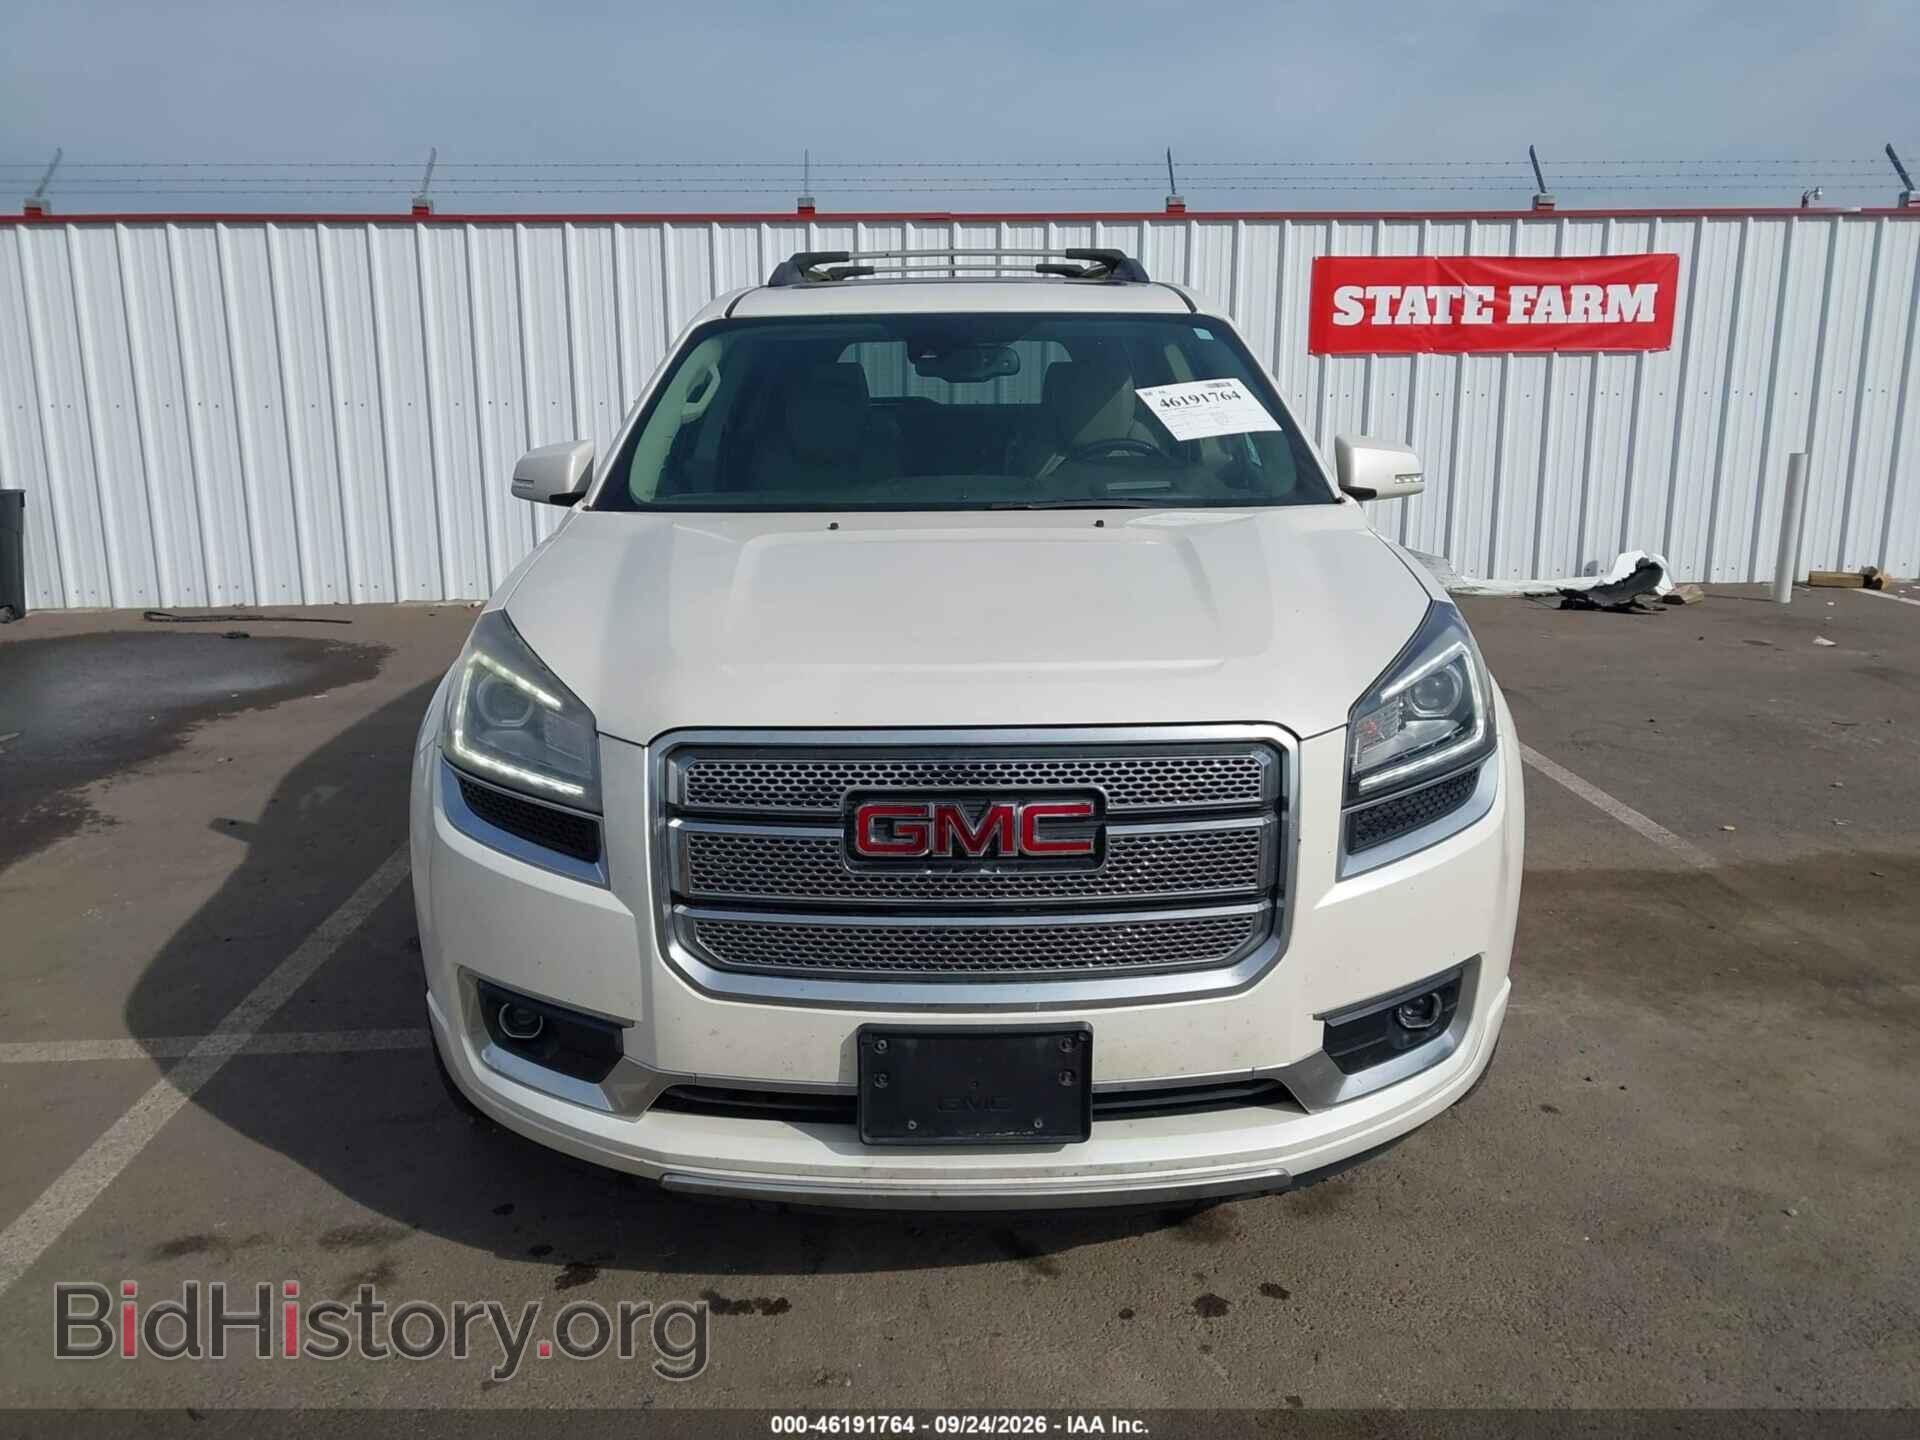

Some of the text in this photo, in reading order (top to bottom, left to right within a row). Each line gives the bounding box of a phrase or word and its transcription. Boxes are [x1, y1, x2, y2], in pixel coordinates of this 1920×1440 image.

[1332, 283, 1658, 327] STATE FARM
[1160, 389, 1242, 409] 46191764
[856, 801, 1095, 857] GMC
[935, 1096, 1016, 1113] GMC
